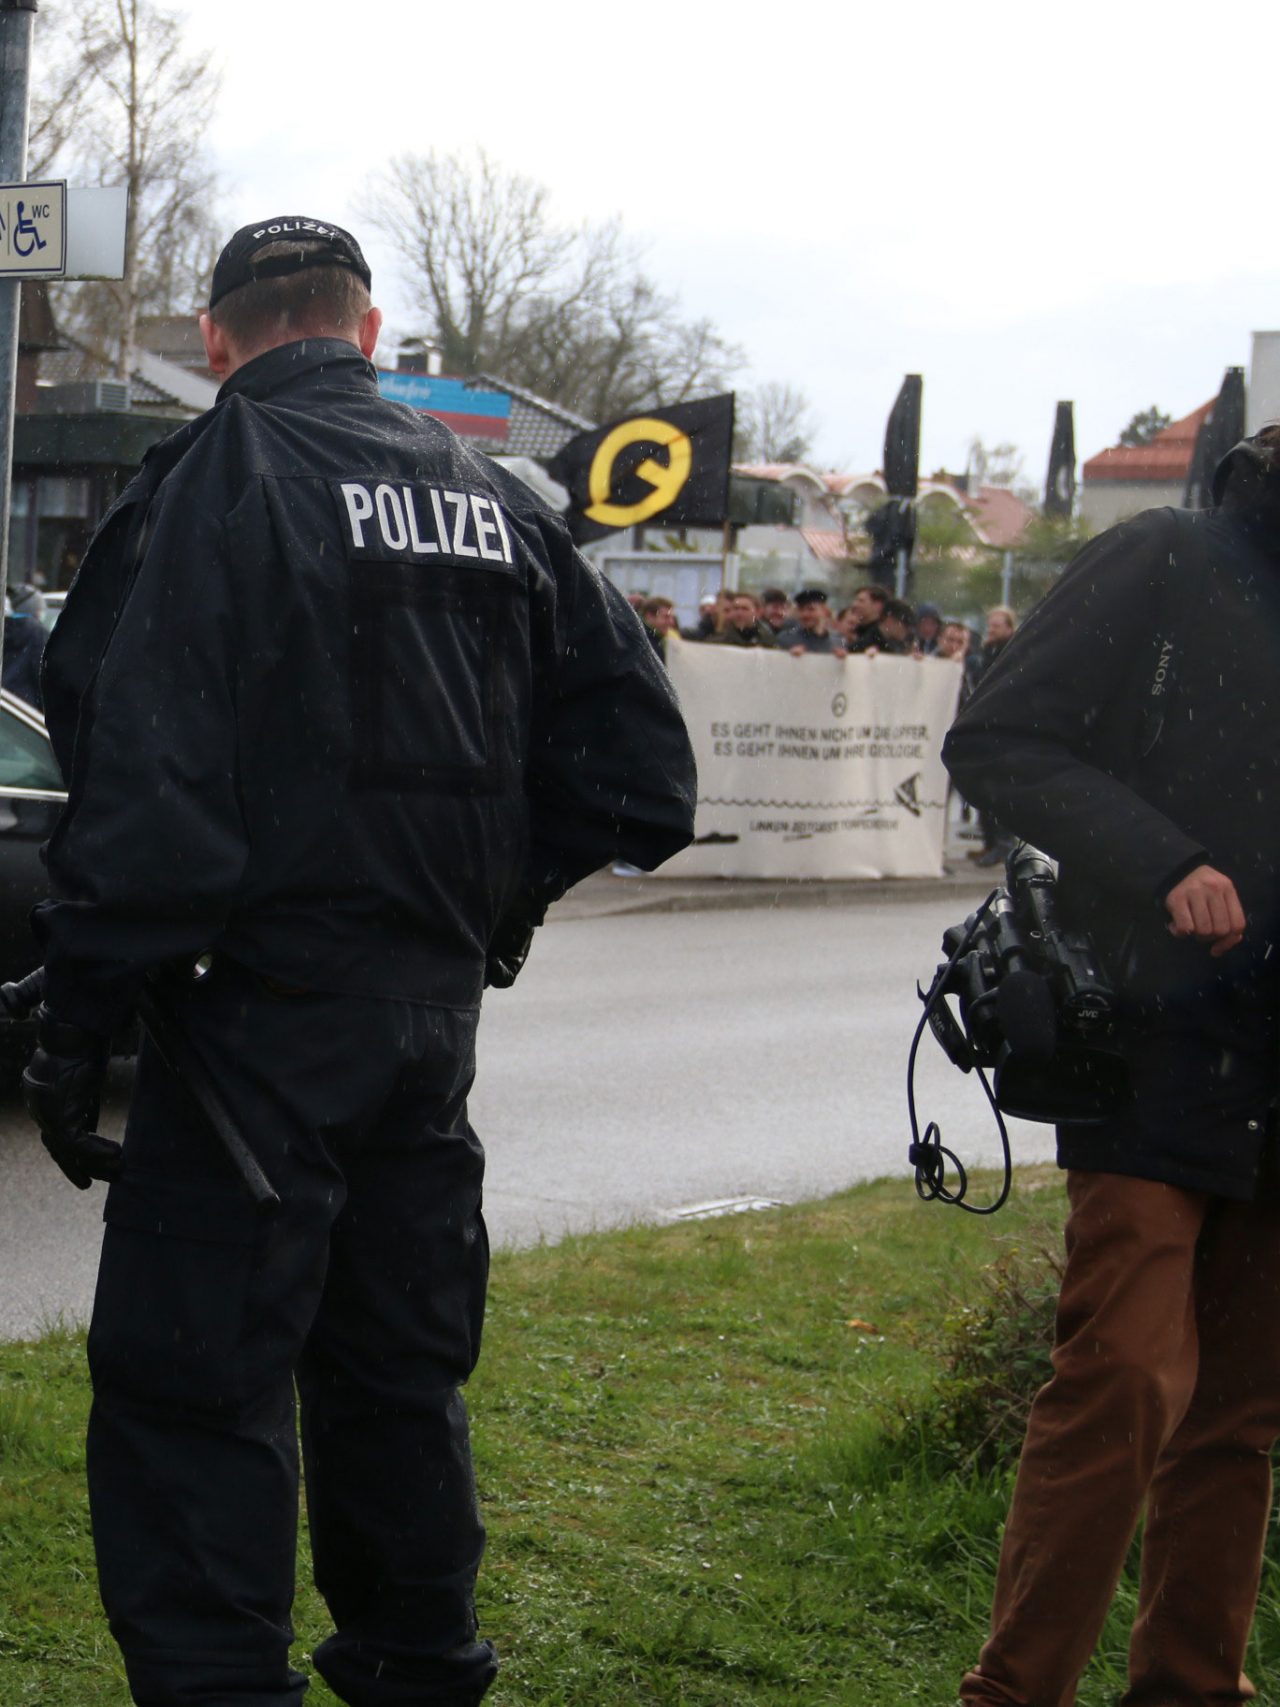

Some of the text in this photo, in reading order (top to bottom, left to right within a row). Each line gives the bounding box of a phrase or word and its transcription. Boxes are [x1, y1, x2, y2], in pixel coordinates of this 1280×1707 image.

[32, 204, 50, 218] WC
[340, 483, 513, 564] POLIZEI
[1152, 640, 1173, 696] SONY
[710, 722, 731, 738] ES
[733, 723, 772, 739] GEHT
[775, 725, 816, 741] IHNEN
[820, 726, 855, 742] NICHT
[713, 742, 732, 757] ES
[736, 742, 774, 758] GEHT
[777, 744, 819, 760] IHNEN
[822, 745, 841, 761] UM
[1077, 1009, 1099, 1018] JVC
